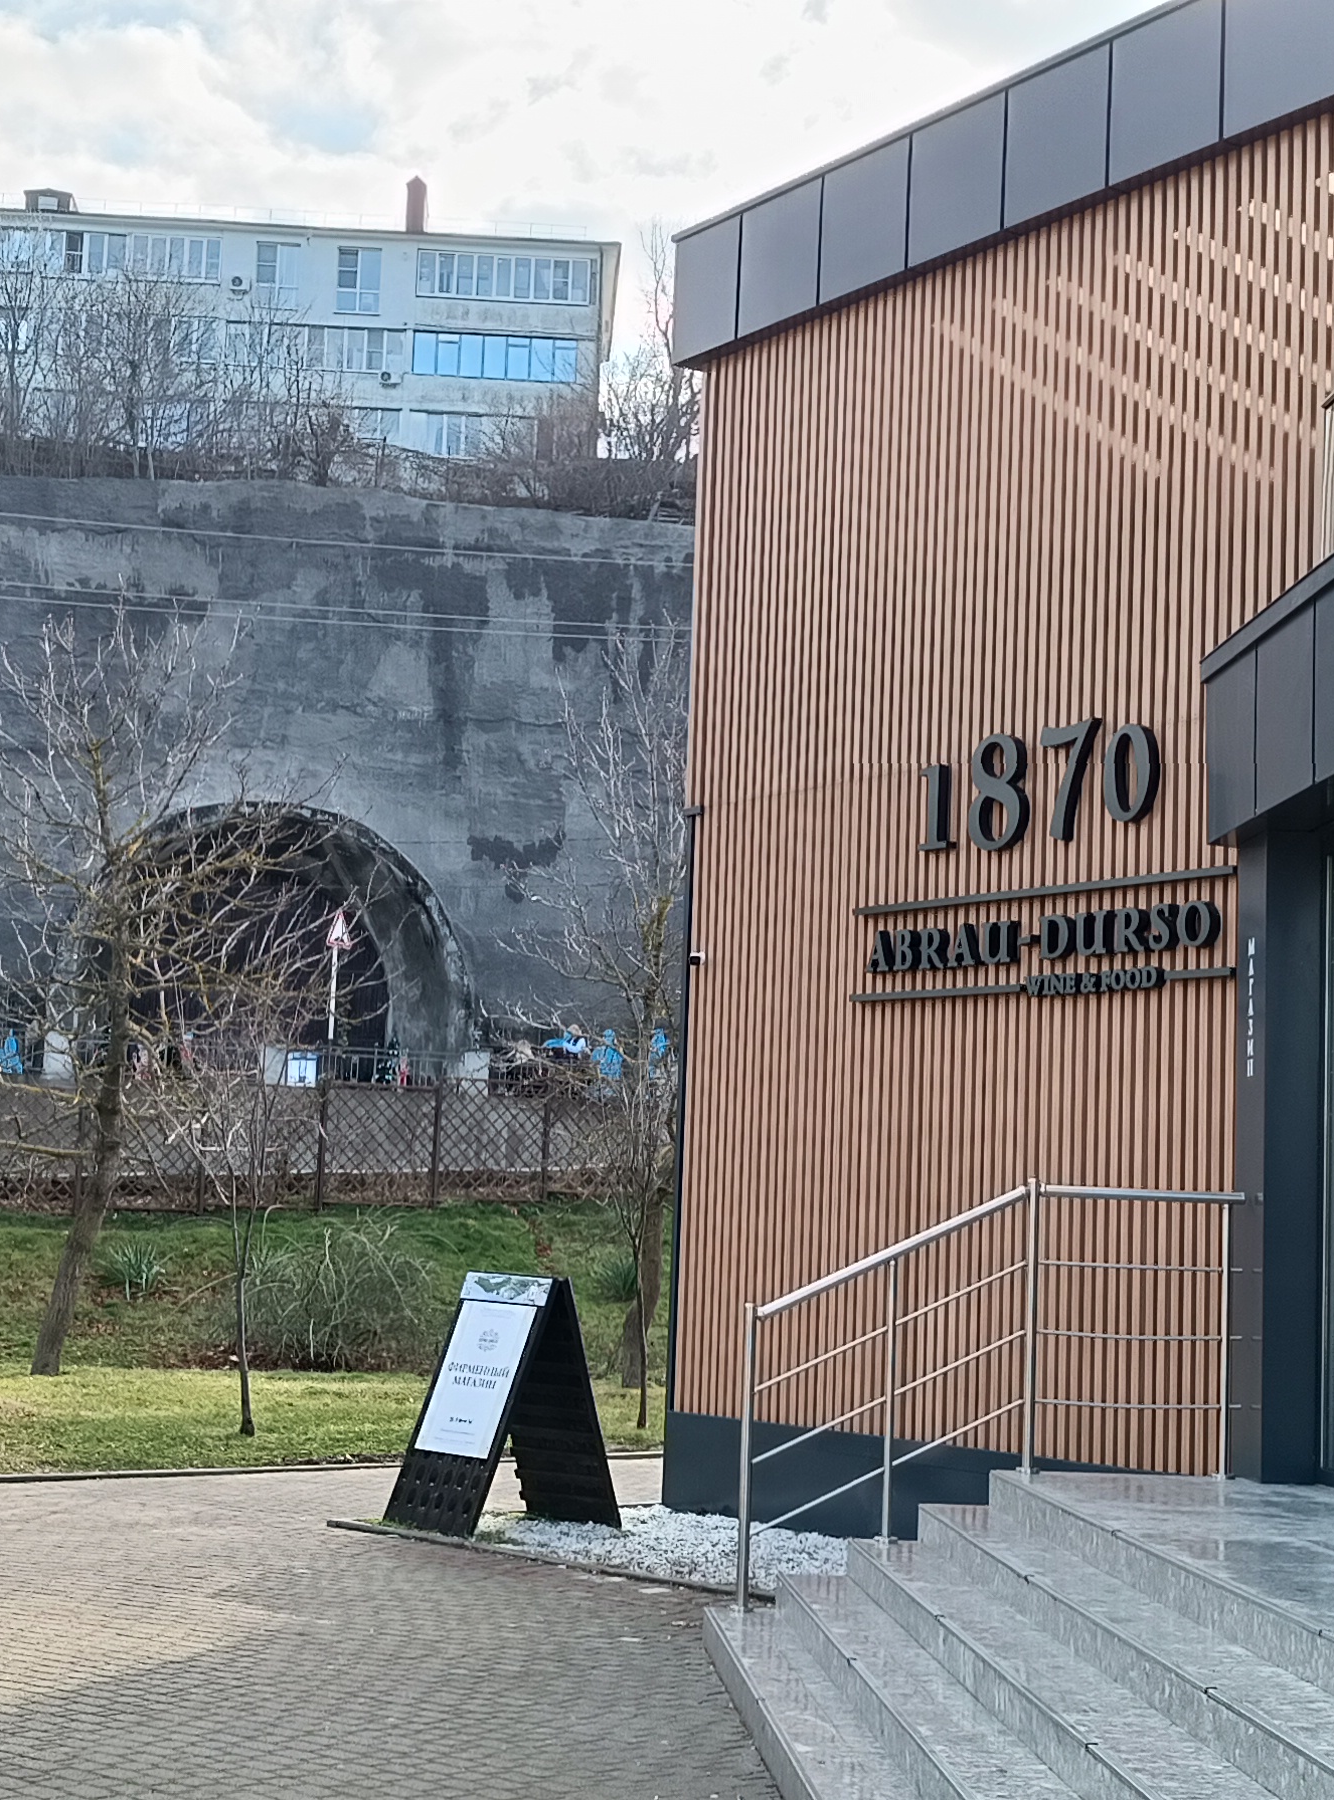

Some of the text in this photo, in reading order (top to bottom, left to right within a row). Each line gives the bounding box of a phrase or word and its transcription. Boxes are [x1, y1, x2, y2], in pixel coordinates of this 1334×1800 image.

[917, 717, 1161, 853] 1870
[865, 900, 1222, 974] ABRAU-DURSO
[1025, 965, 1162, 997] WINE & FOOD
